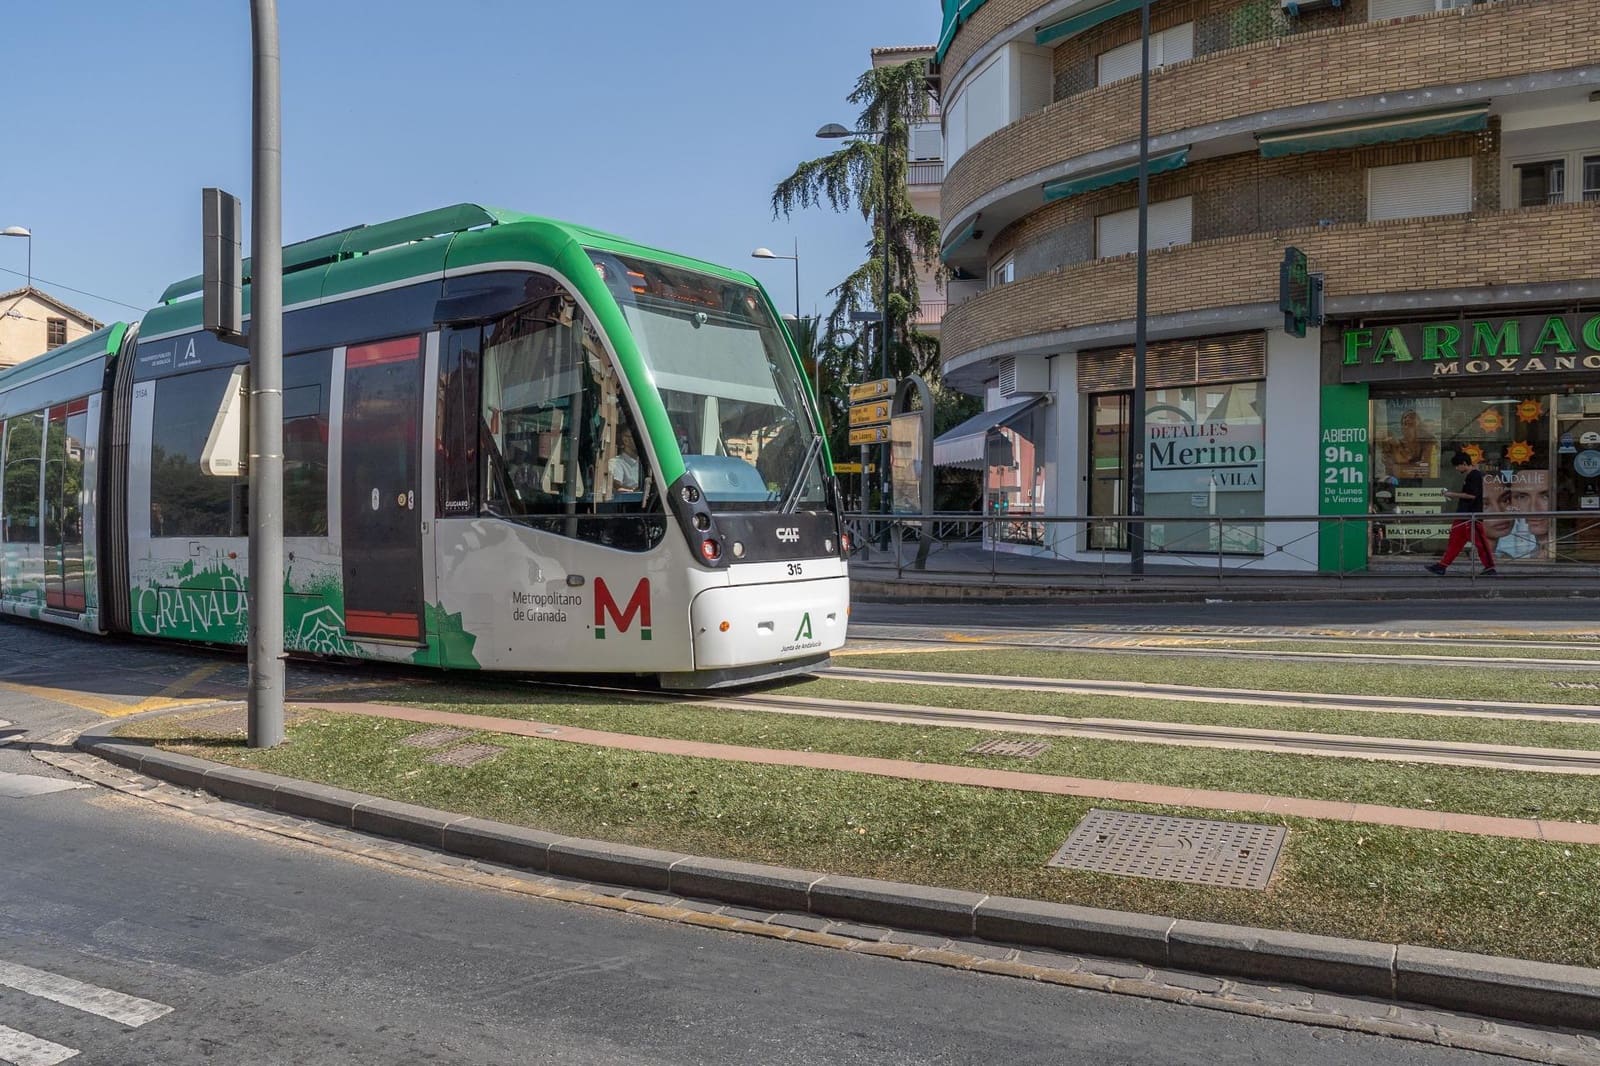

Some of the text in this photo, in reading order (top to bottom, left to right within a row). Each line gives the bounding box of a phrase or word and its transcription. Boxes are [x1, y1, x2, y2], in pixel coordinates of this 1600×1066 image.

[1433, 355, 1600, 376] MOYANO
[1151, 423, 1228, 440] DETALLES
[1322, 428, 1367, 443] ABIERTO
[1151, 438, 1257, 466] Merino
[1325, 446, 1364, 463] 9h a
[1208, 469, 1257, 486] ÁVILA
[1325, 467, 1363, 483] 21h
[1325, 487, 1363, 495] De Lunes
[1332, 495, 1363, 503] Viernes
[787, 563, 803, 576] 315
[138, 576, 249, 635] GRANADA
[512, 576, 652, 640] Metropolitano M
[513, 608, 567, 623] de Granada
